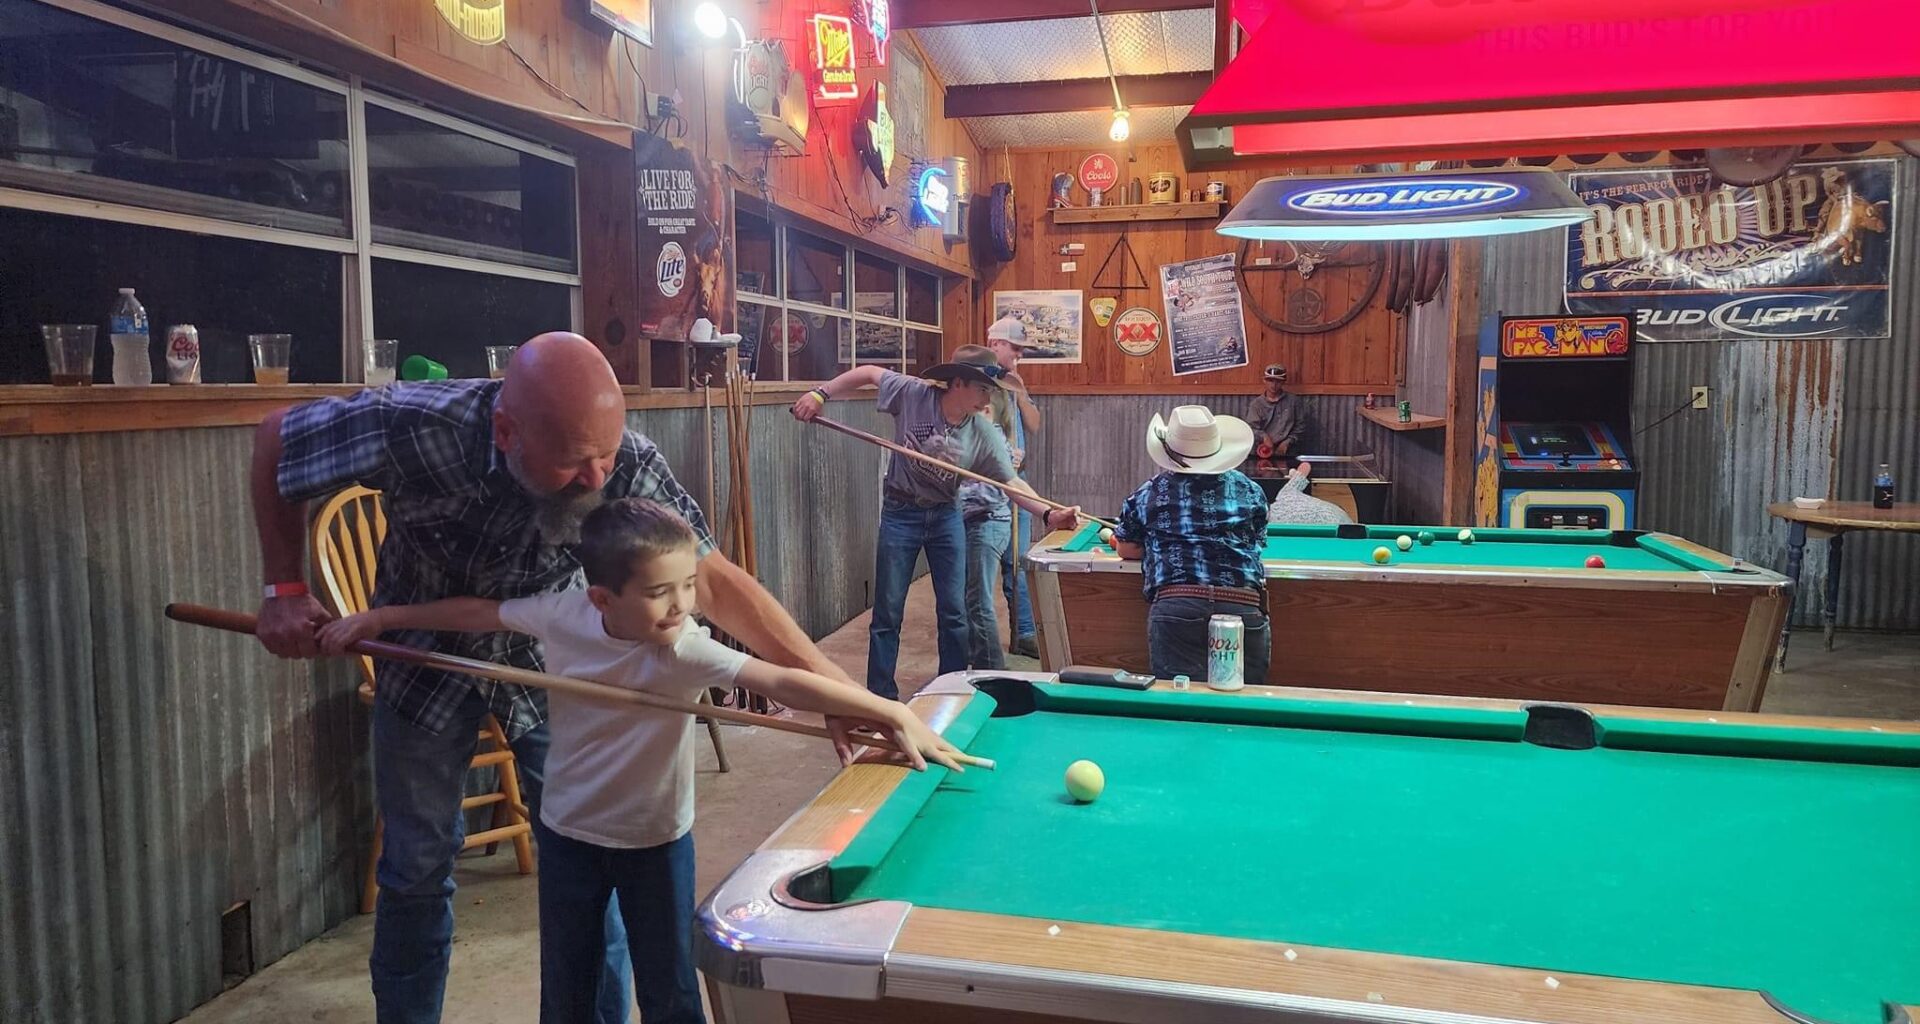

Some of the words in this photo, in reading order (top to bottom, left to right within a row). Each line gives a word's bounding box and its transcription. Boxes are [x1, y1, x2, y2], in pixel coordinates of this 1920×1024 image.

[820, 21, 850, 64] Miller
[1474, 26, 1551, 55] THIS
[1565, 17, 1669, 50] BUD'S
[1682, 11, 1752, 43] FOR
[643, 169, 670, 190] LIVE
[671, 169, 692, 190] FOR
[1087, 170, 1111, 181] Coors
[1301, 191, 1387, 207] BUD
[1388, 186, 1508, 204] LIGHT
[1579, 190, 1600, 202] IT'S
[1601, 186, 1623, 199] THE
[1626, 179, 1674, 195] PERFECT
[1676, 174, 1704, 188] RIDE
[644, 190, 669, 211] THE
[669, 190, 695, 210] RIDE
[1580, 190, 1738, 266] RODEO
[1753, 173, 1818, 238] UP
[660, 258, 684, 282] Lite
[1636, 308, 1708, 325] BUD
[1726, 306, 1848, 325] LIGHT
[1513, 339, 1606, 357] PAC-MAN
